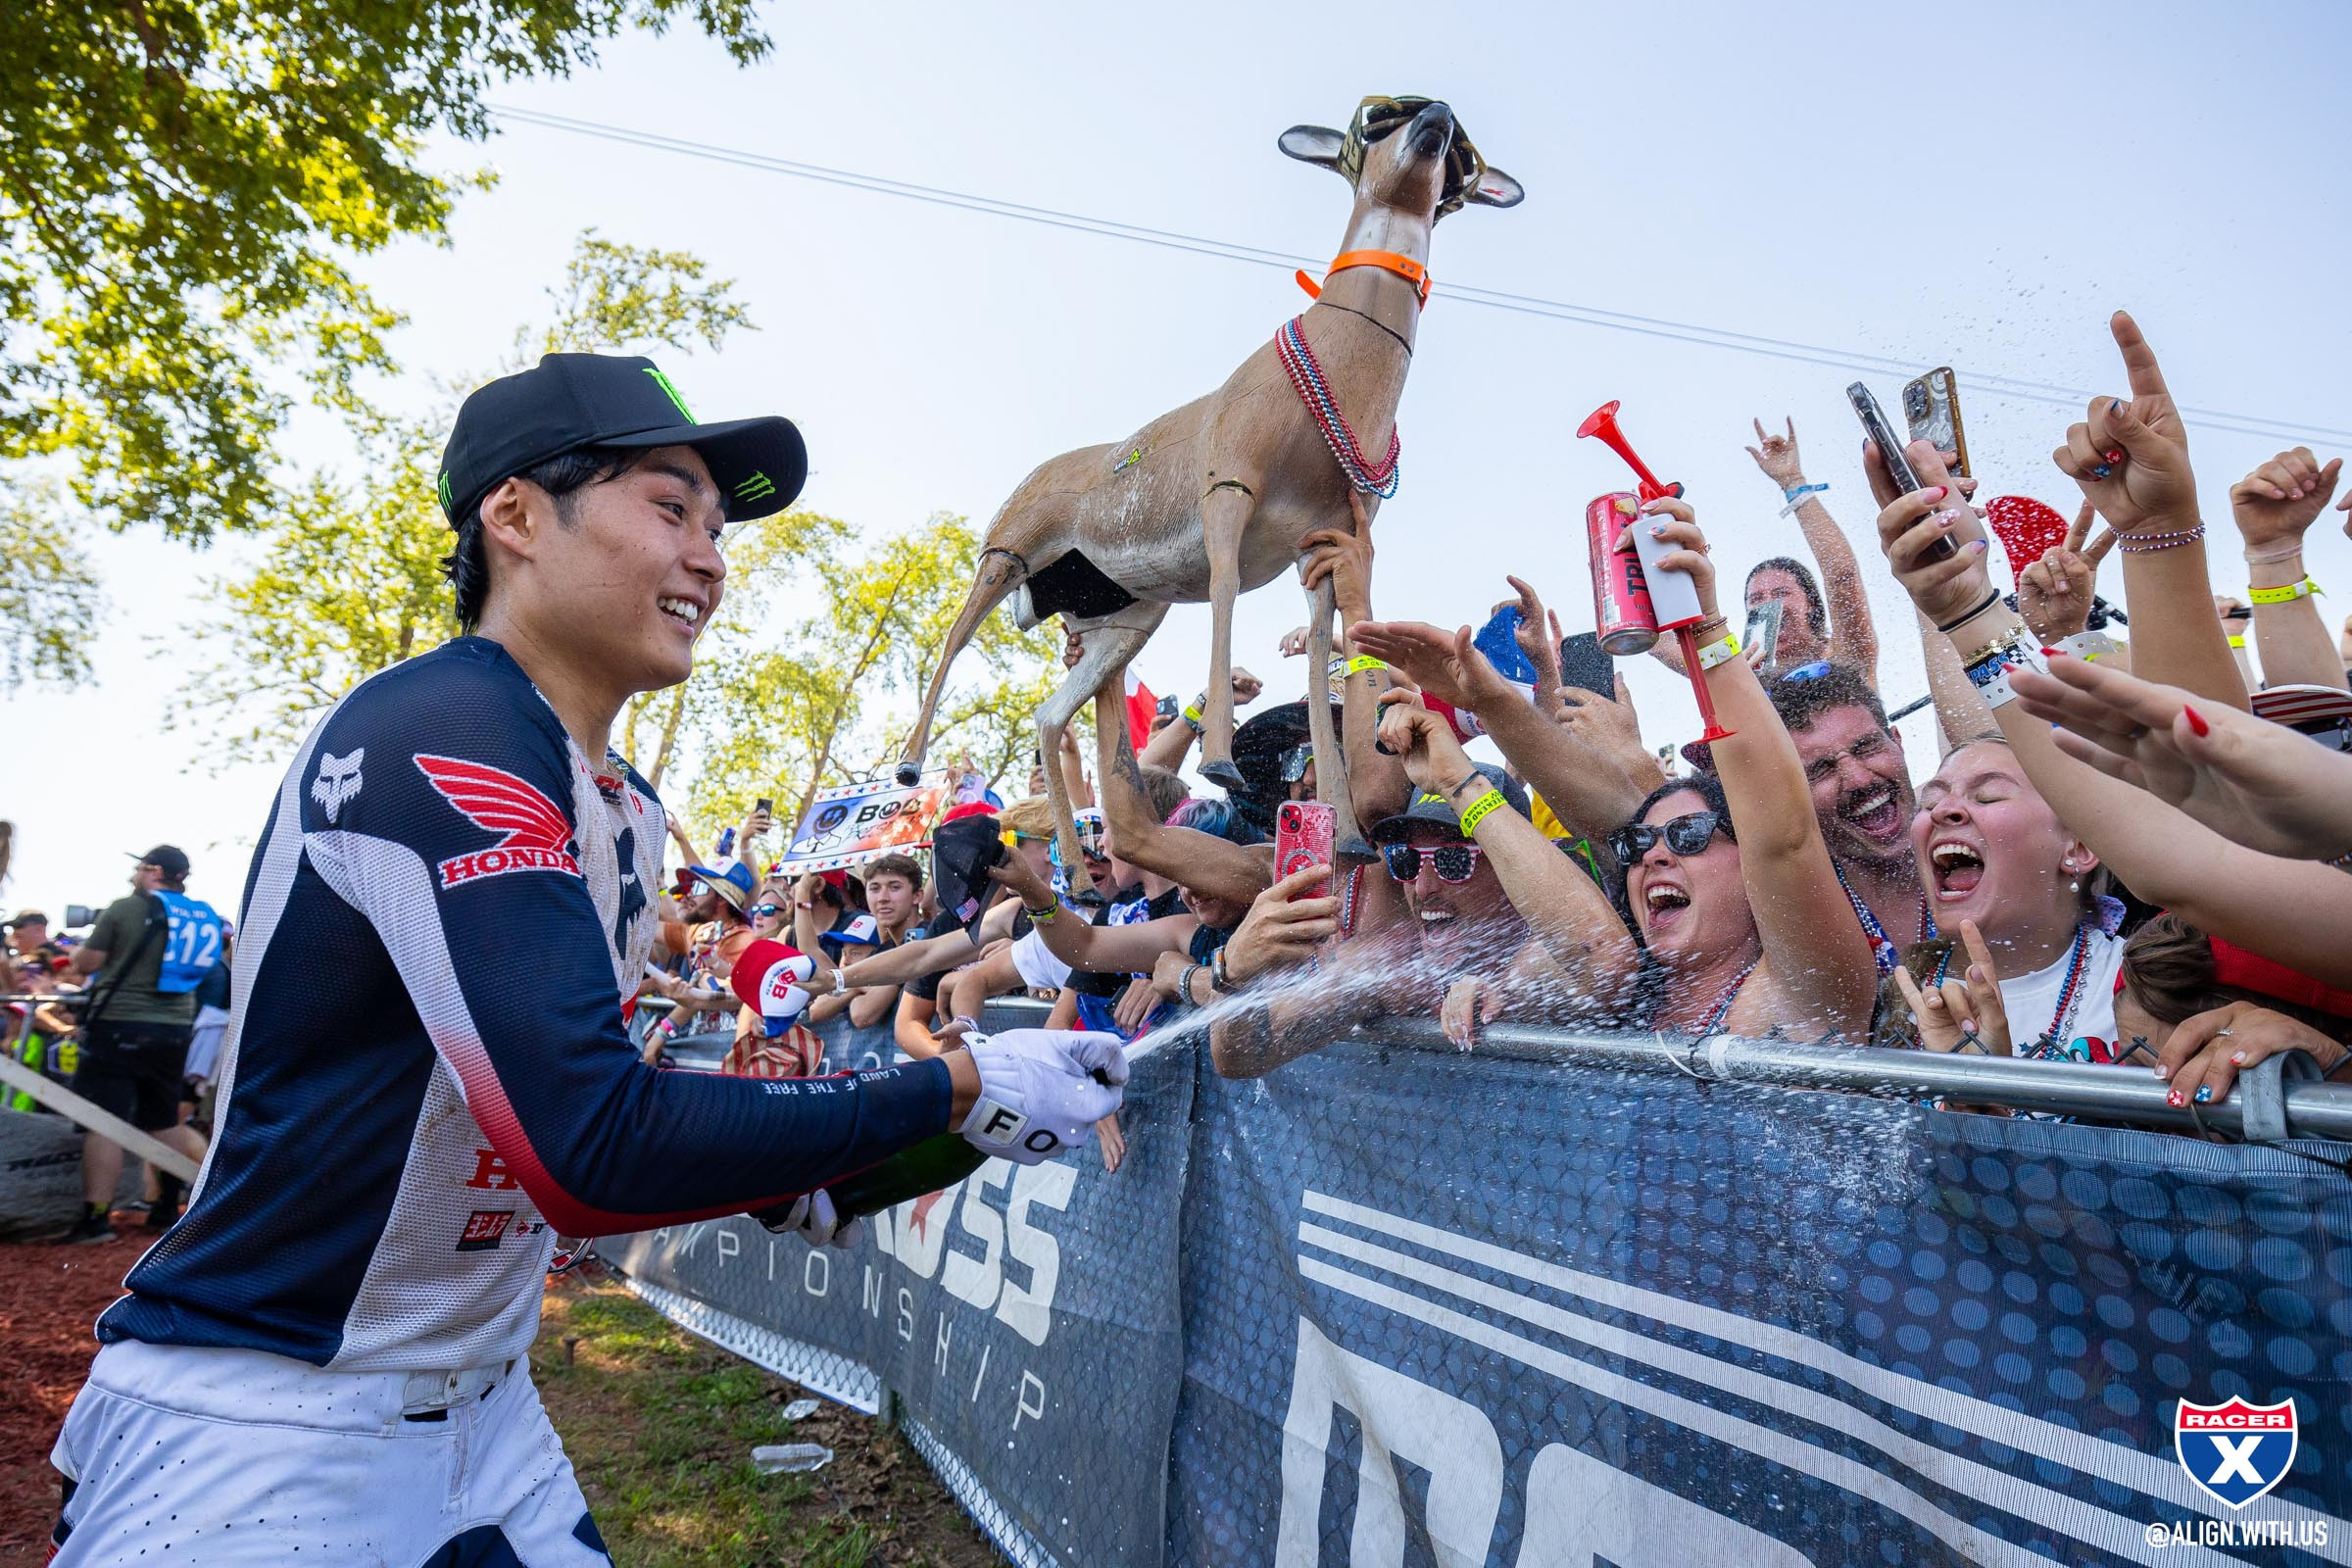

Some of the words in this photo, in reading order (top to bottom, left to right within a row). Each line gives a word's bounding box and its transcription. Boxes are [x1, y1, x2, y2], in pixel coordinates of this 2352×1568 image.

[441, 849, 581, 886] HONDA
[859, 1068, 902, 1082] LAND
[761, 1082, 799, 1095] FREE
[806, 1082, 836, 1095] THE
[983, 1107, 1059, 1153] FO
[653, 1223, 1046, 1432] AMPIONSHIP
